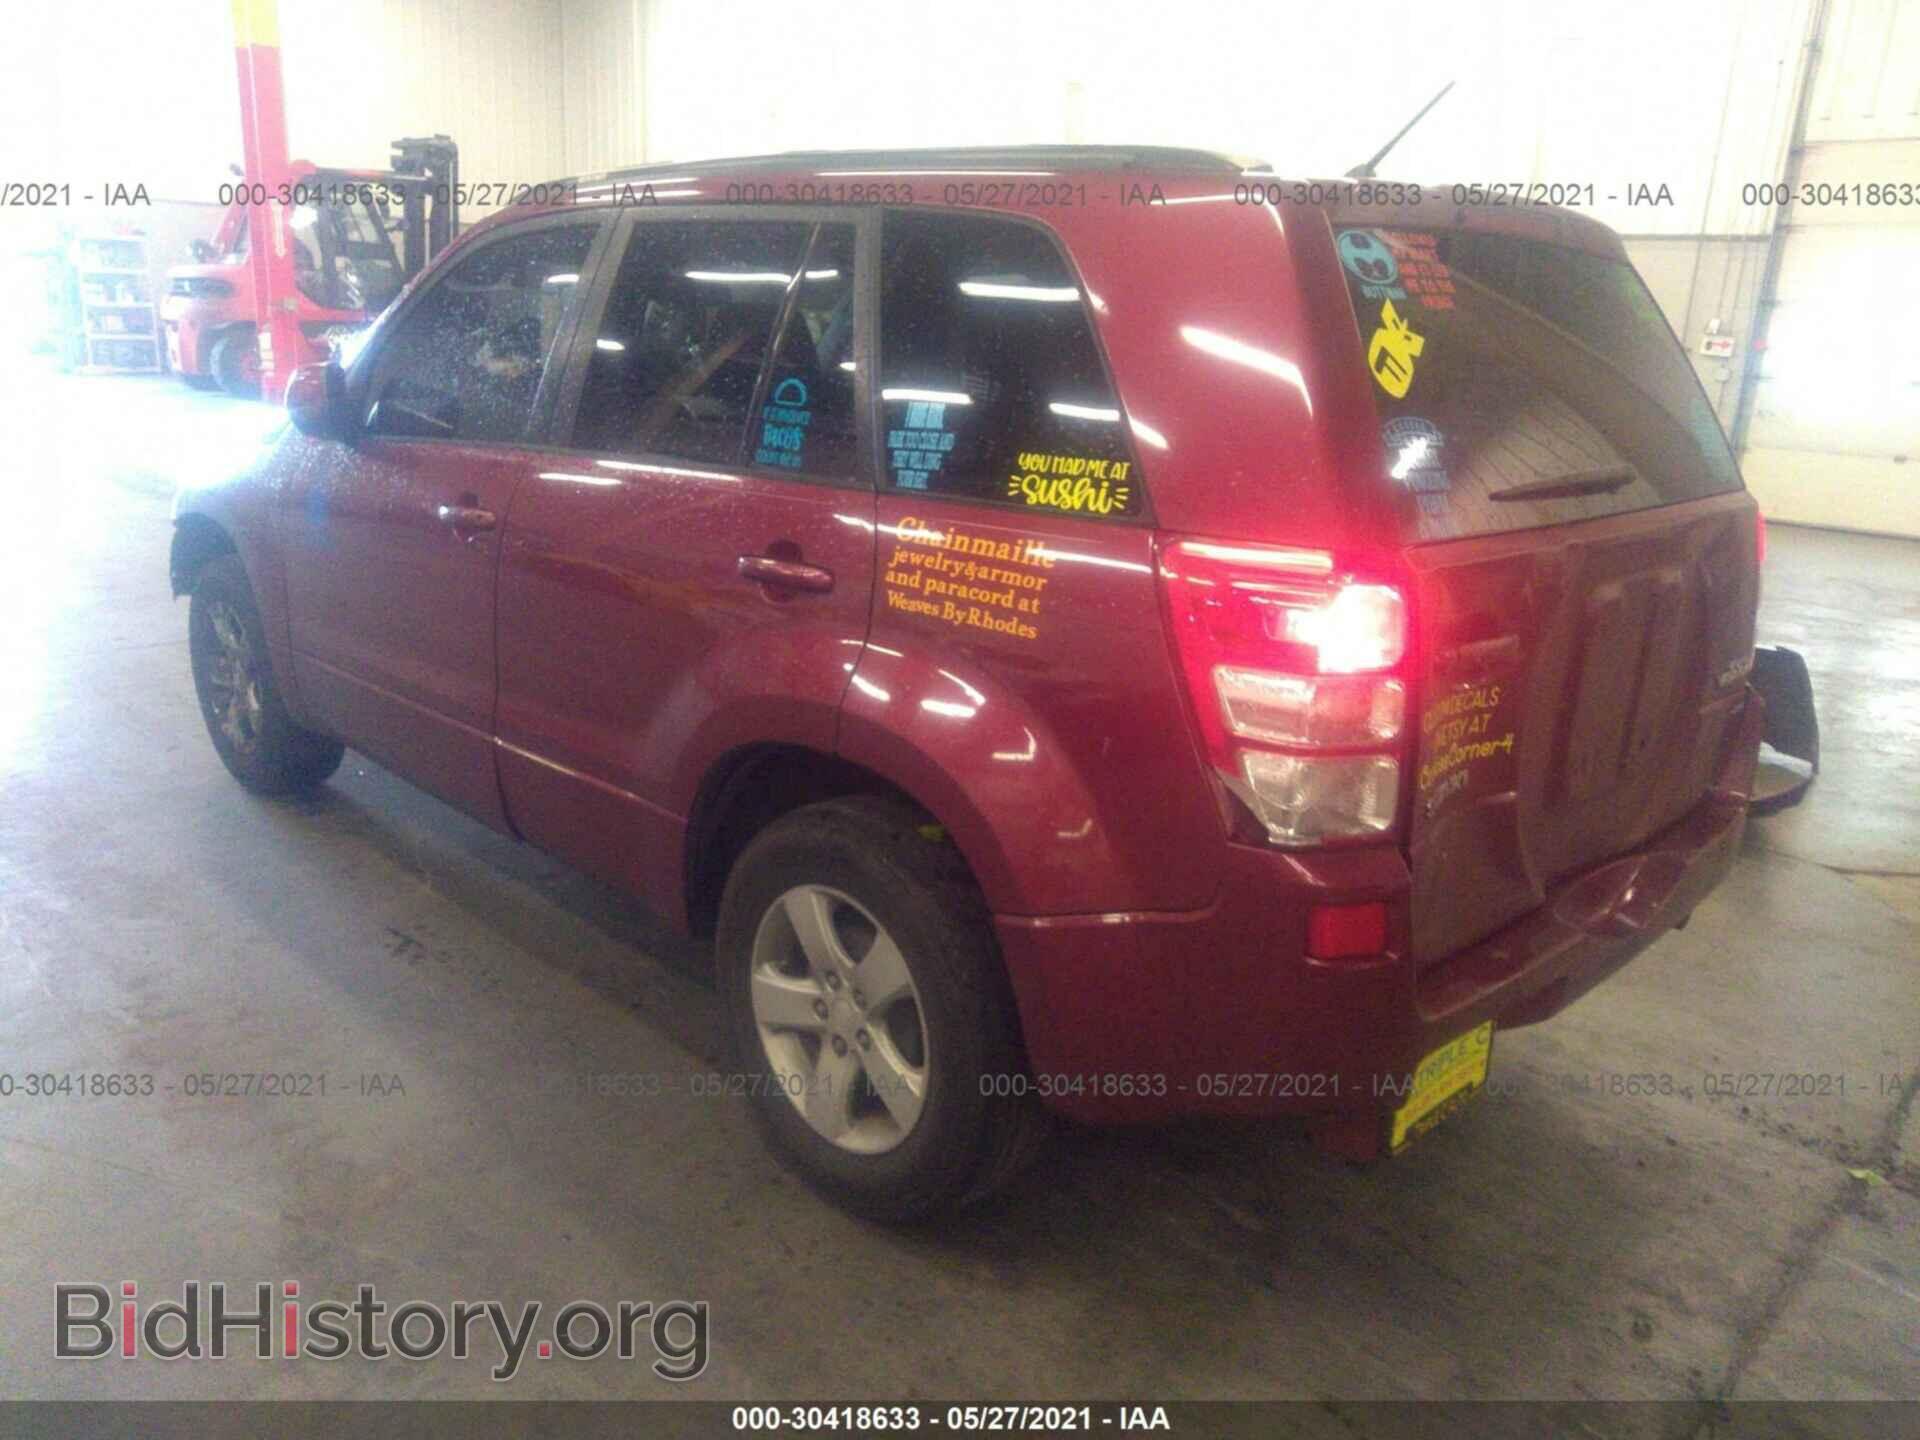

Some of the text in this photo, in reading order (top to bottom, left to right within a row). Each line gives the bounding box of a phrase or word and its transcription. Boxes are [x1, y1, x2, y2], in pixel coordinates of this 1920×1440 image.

[1018, 452, 1131, 480] YOU HAD ME AT
[885, 569, 1041, 614] and paracord at
[887, 590, 939, 617] Weaves
